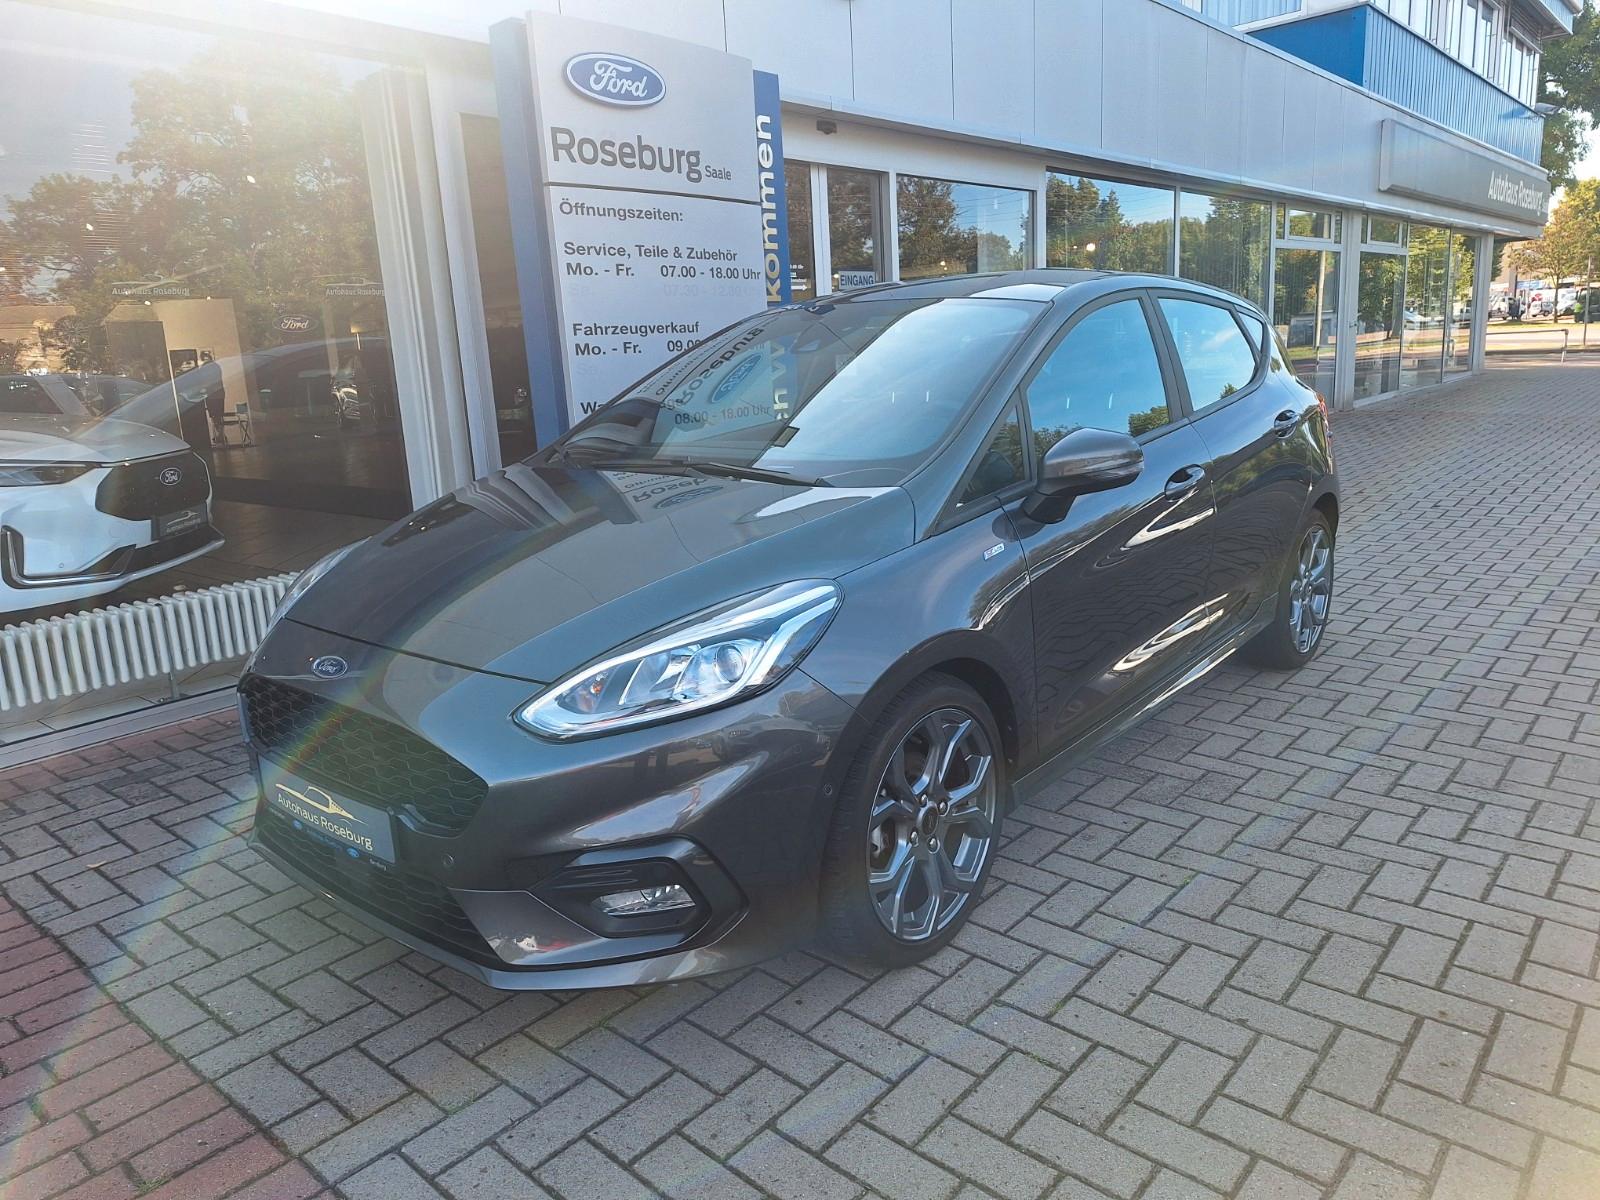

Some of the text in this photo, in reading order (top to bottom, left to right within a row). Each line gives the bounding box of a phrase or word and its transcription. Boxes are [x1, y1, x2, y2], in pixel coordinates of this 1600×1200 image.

[550, 126, 732, 183] Roseburg Saale
[559, 197, 684, 222] Öffnungszeiten:
[563, 241, 738, 262] Service, Teile & Zubehör
[566, 262, 599, 276] Mo.
[615, 263, 635, 277] Fr.
[660, 265, 697, 279] 07.00
[709, 267, 739, 280] 18.00
[742, 268, 761, 281] Uhr
[840, 274, 875, 286] EINGANG
[572, 321, 700, 337] Fahrzeugverkauf
[575, 342, 607, 356] Mo.
[623, 342, 642, 355] Fr.
[278, 793, 320, 825] Autohaus
[320, 816, 373, 851] Roseburg
